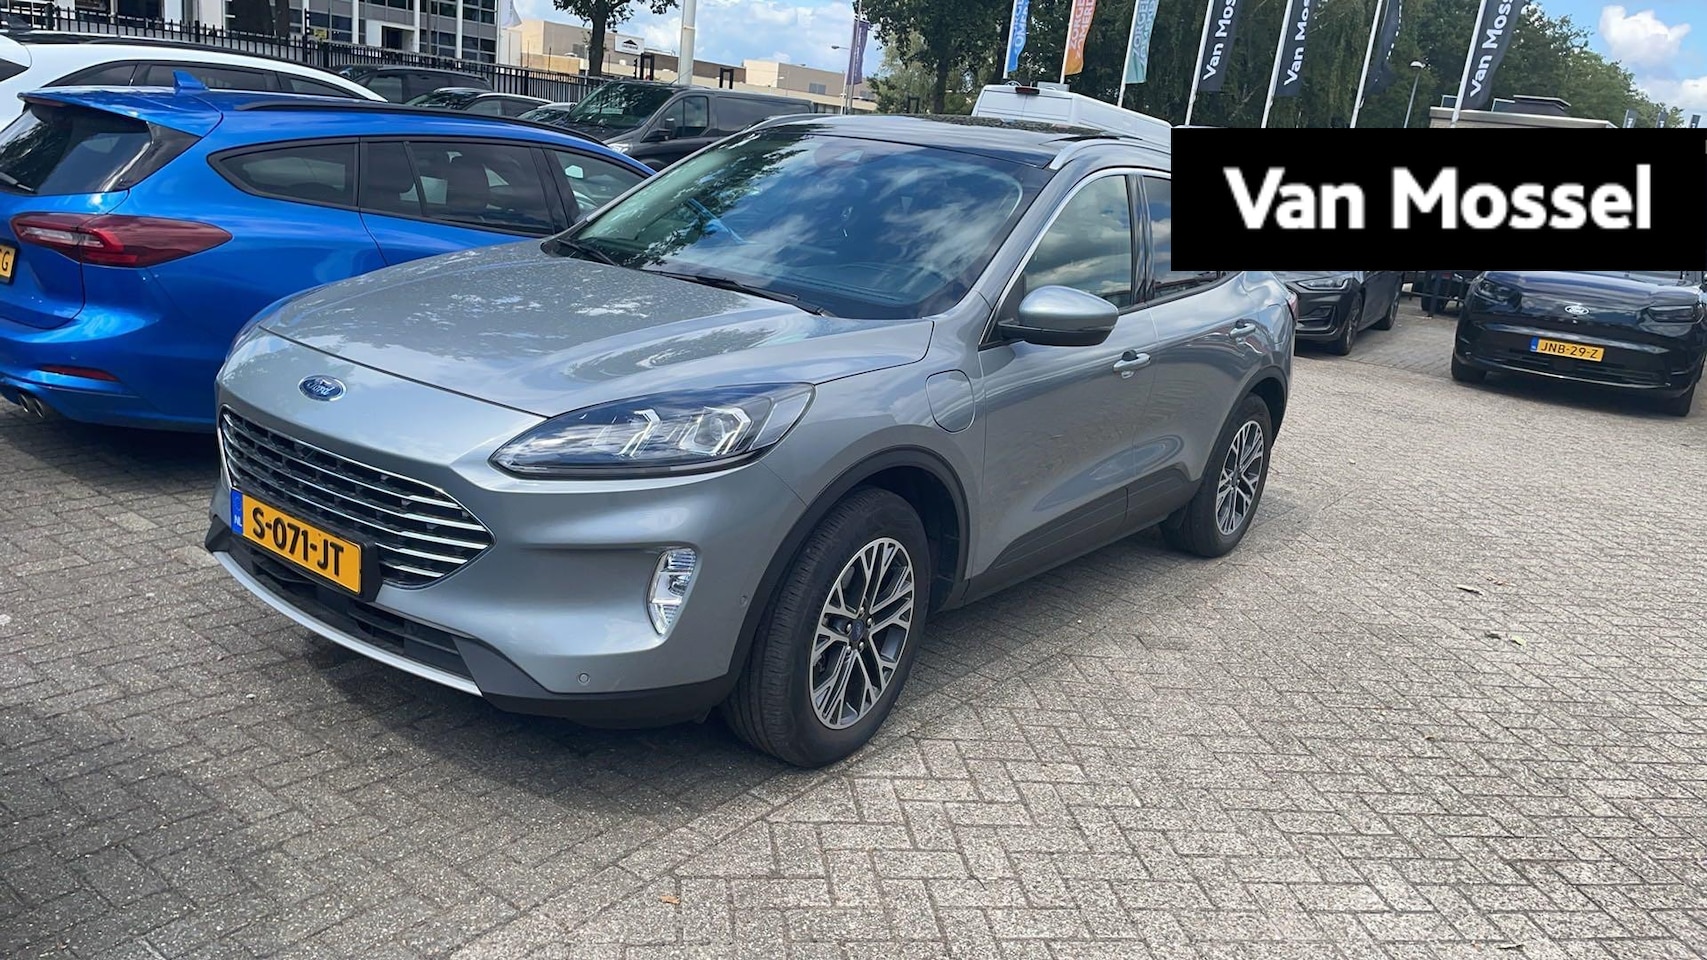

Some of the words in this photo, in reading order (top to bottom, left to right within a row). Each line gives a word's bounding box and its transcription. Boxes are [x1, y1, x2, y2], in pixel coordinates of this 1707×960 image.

[1203, 42, 1224, 80] Van
[1284, 47, 1304, 85] Van
[1470, 55, 1493, 97] Van
[1482, 0, 1513, 49] Mos
[1541, 342, 1598, 359] JNB-29-Z
[233, 514, 242, 527] NL
[252, 507, 344, 576] S-071-JT
